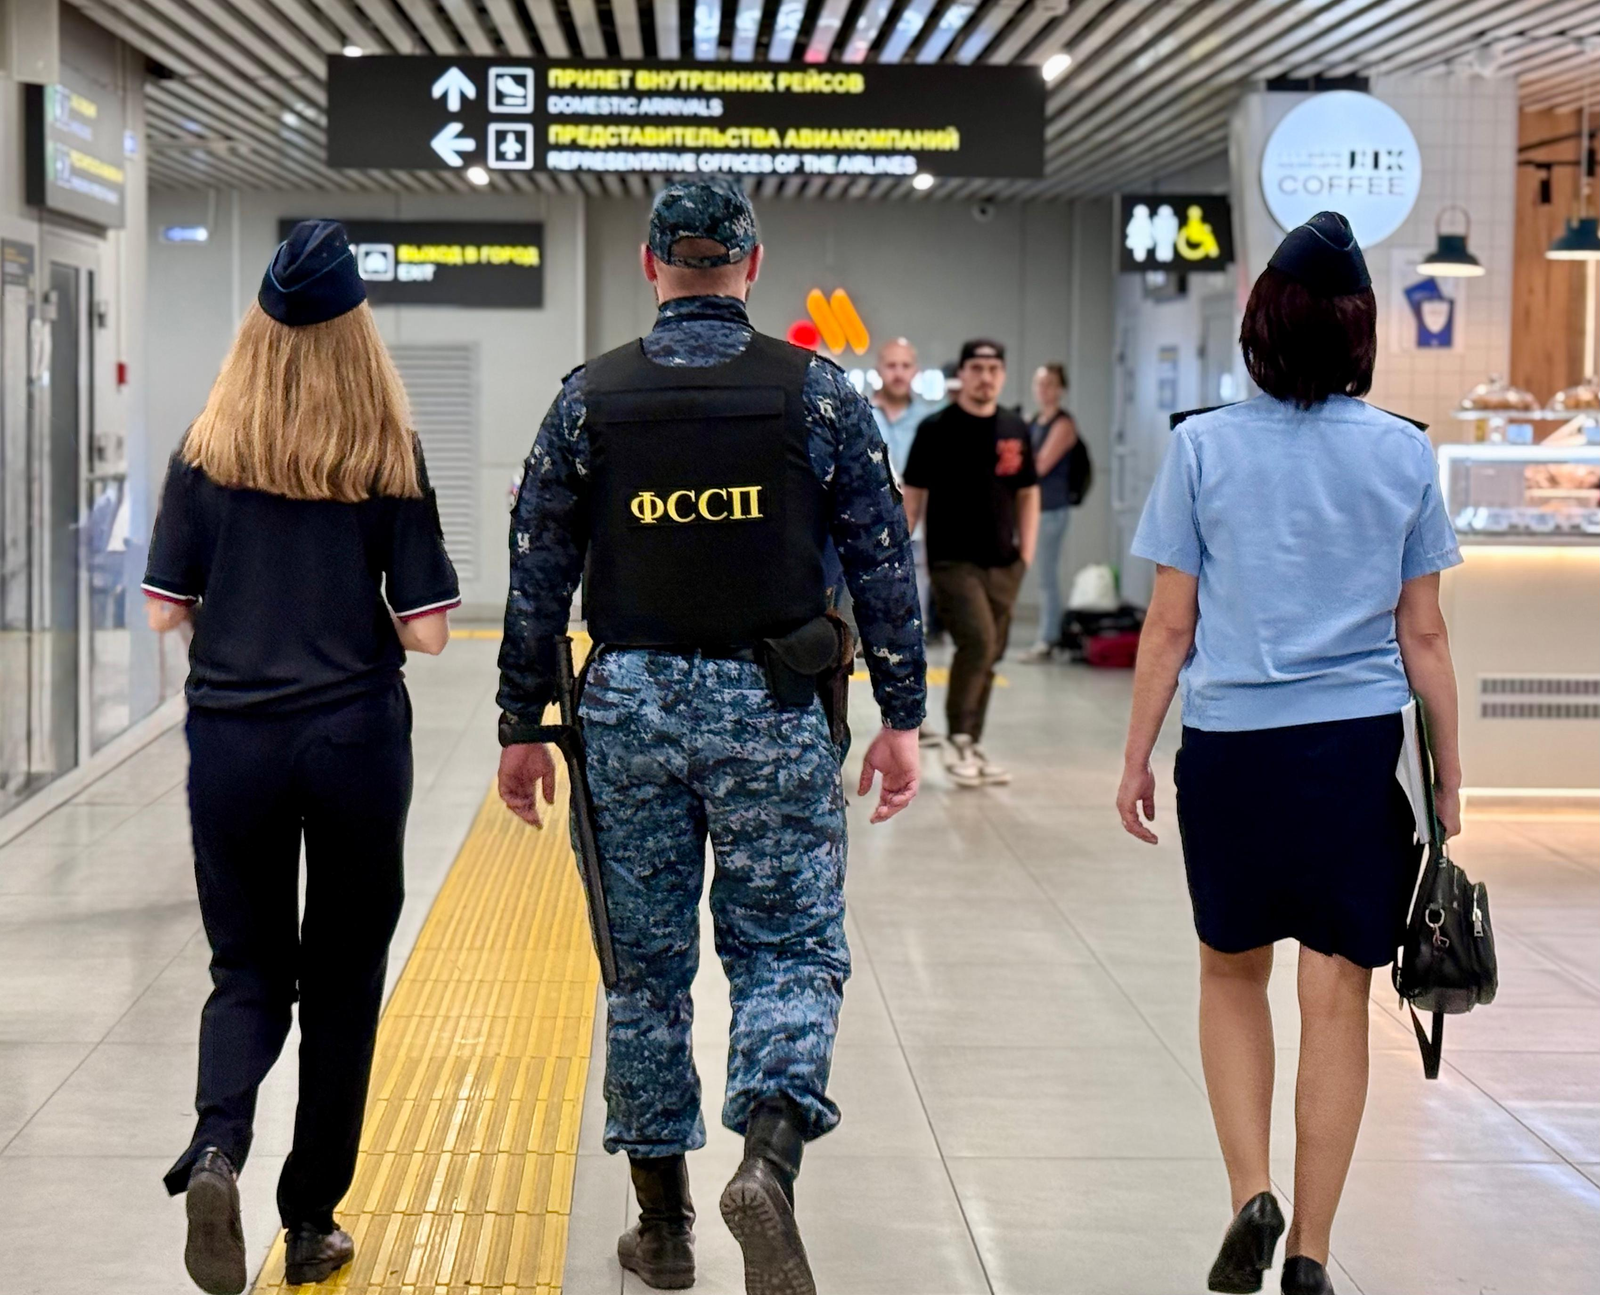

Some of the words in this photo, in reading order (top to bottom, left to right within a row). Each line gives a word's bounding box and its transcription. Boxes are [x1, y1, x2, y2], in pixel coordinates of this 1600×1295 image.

[548, 69, 632, 89] ПРИЛЕТ
[635, 70, 774, 92] ВНУТРЕННИХ
[777, 68, 864, 93] РЕЙСОВ
[547, 95, 638, 115] DOMESTIC
[639, 97, 724, 117] ARRIVALS
[548, 125, 781, 148] ПРЕДСТАВИТЕЛЬСТВА
[783, 126, 960, 150] АВИАКОМПАНИЙ
[547, 151, 697, 172] REPRESENTATIVE
[698, 153, 773, 173] OFFICES
[774, 154, 800, 174] OF
[801, 154, 837, 174] THE
[838, 154, 918, 175] AIRLINES
[1278, 175, 1404, 195] COFFEE
[630, 486, 764, 524] ФССП
